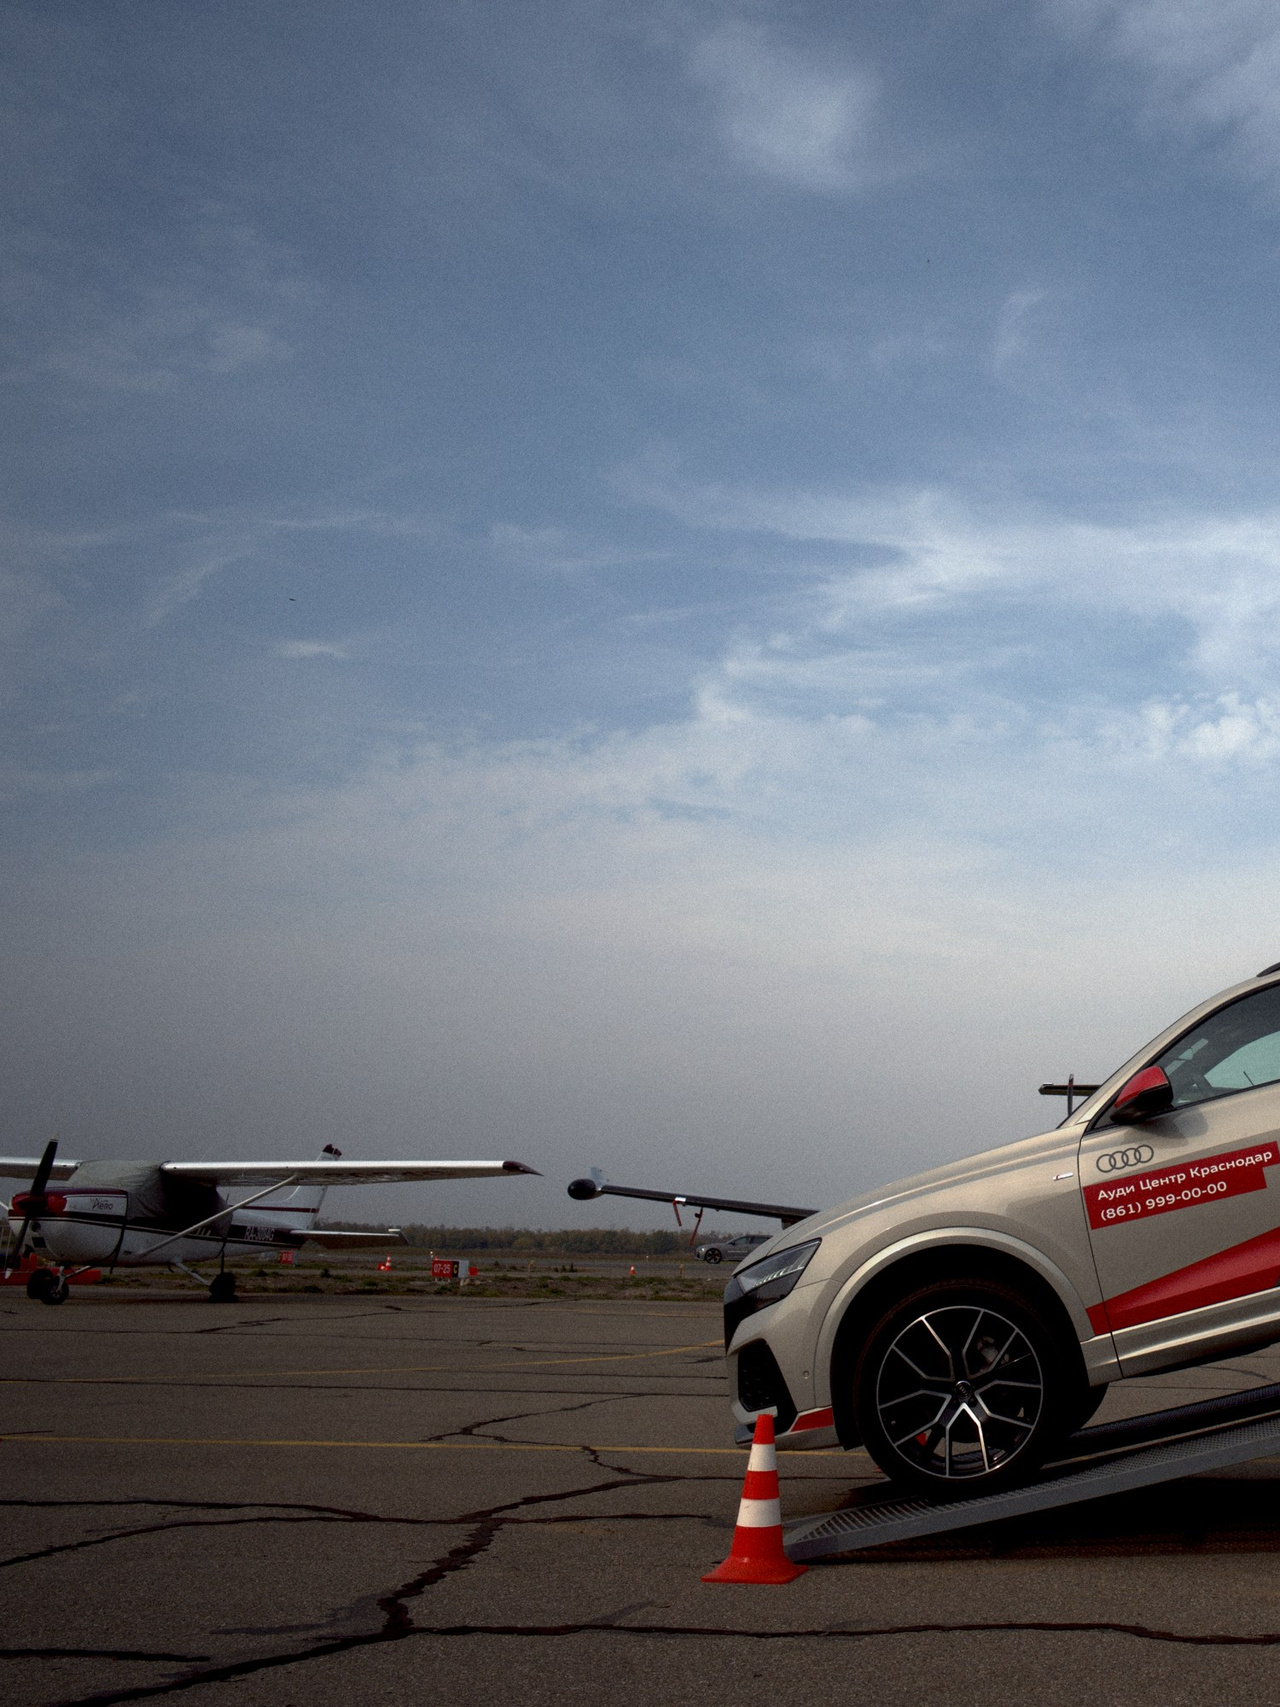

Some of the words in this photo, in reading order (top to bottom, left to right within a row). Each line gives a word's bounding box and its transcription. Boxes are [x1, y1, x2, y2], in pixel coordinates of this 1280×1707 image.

[1098, 1184, 1135, 1201] Ауди
[1139, 1172, 1186, 1191] Центр
[1190, 1151, 1273, 1179] Краснодар
[1100, 1202, 1142, 1221] (861)
[1146, 1181, 1227, 1210] 999-00-00
